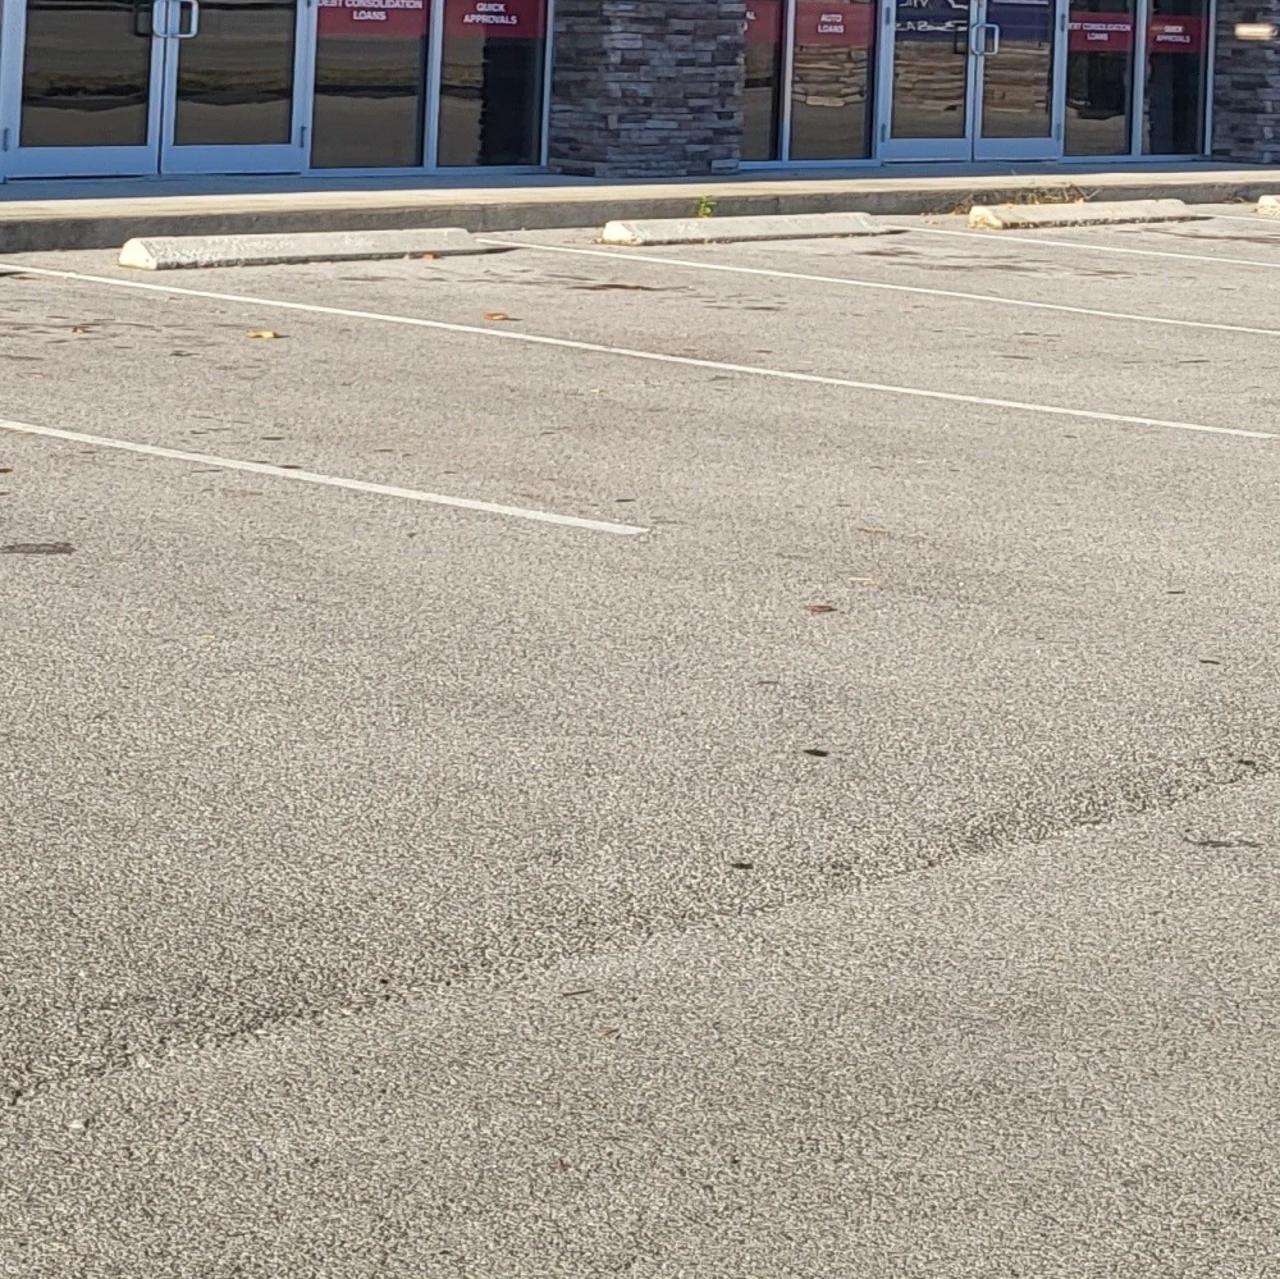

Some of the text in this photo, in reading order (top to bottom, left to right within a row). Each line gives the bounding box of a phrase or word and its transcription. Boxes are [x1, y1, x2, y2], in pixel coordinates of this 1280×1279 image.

[476, 2, 506, 12] QUICK
[353, 10, 387, 21] LOANS
[463, 14, 518, 25] APPROVALS
